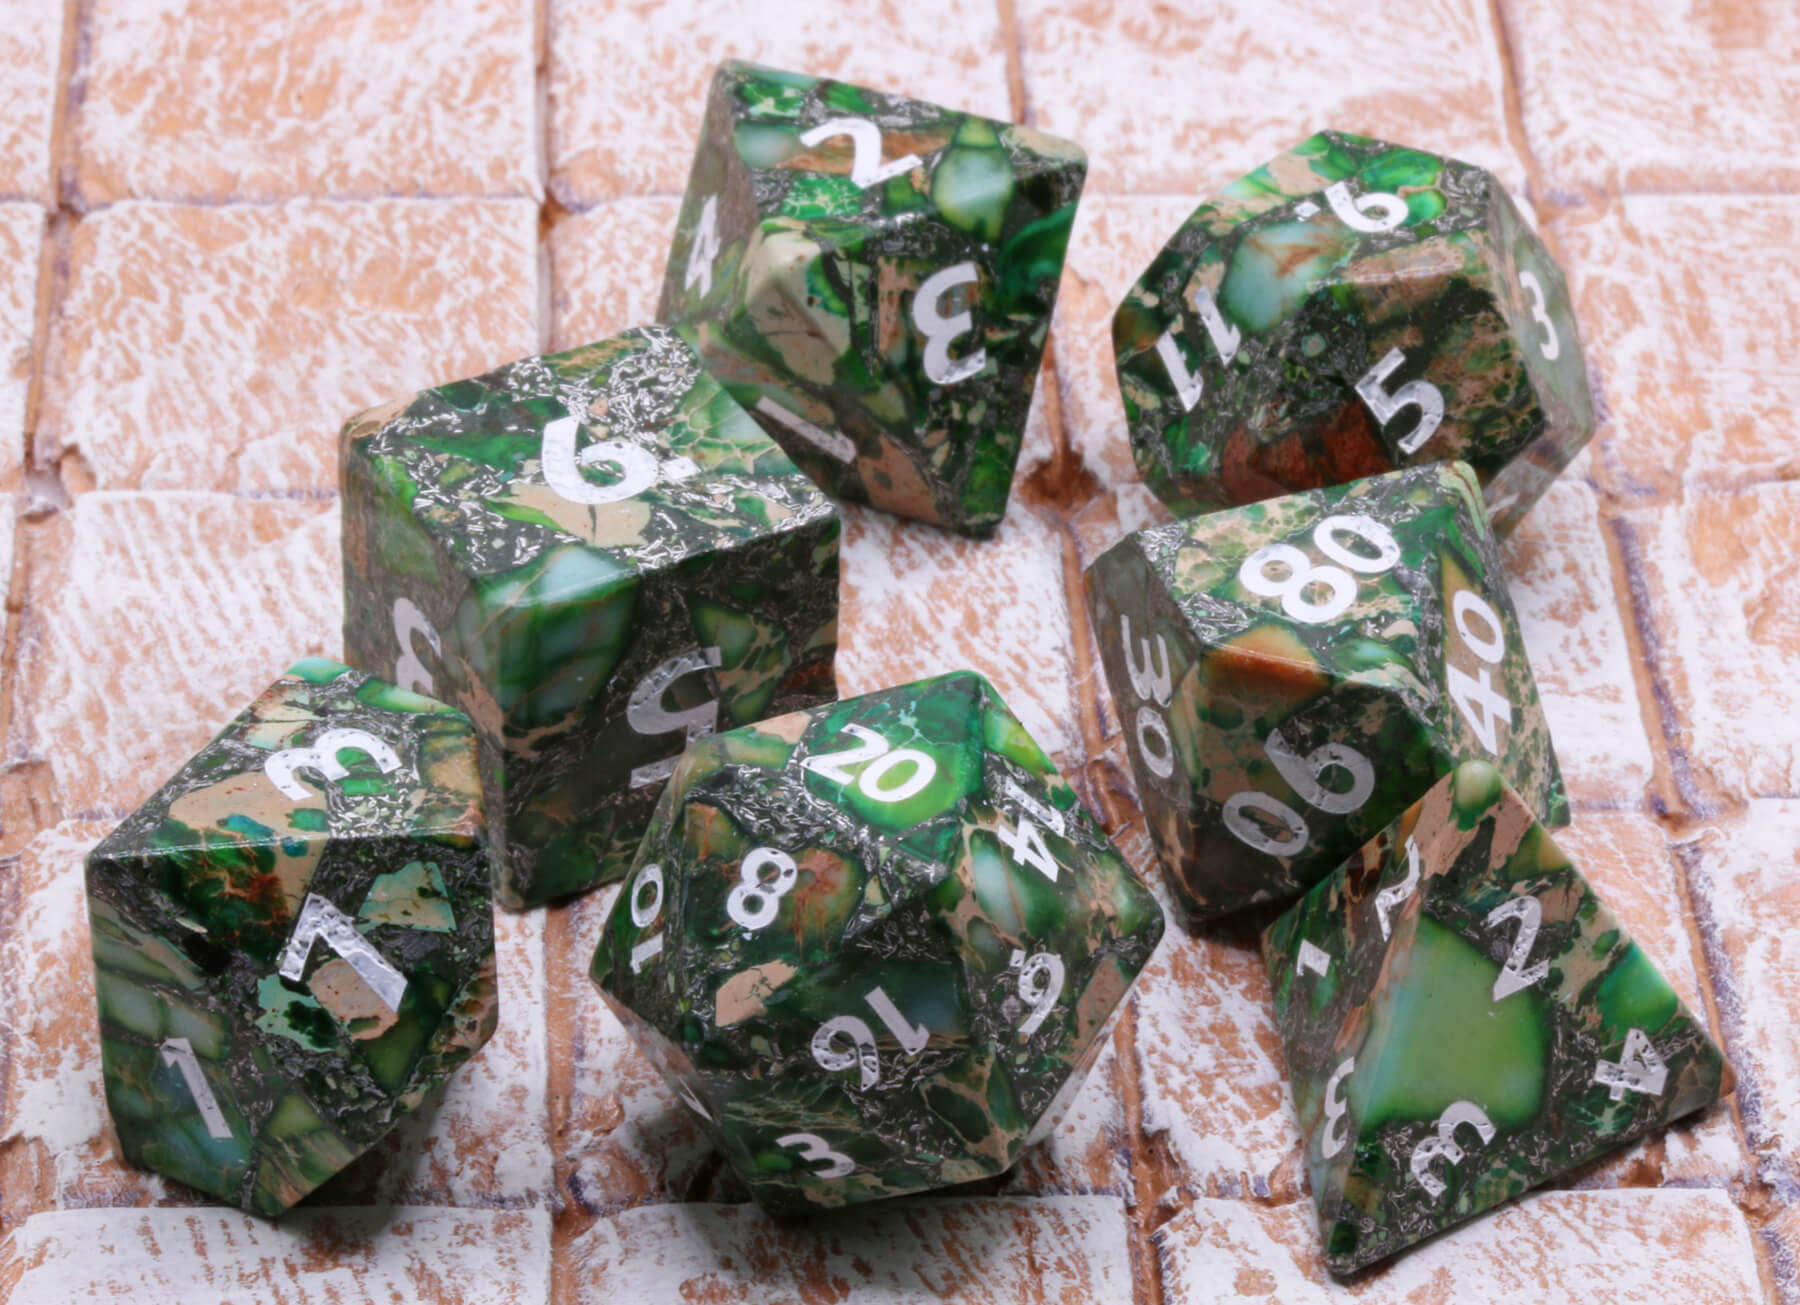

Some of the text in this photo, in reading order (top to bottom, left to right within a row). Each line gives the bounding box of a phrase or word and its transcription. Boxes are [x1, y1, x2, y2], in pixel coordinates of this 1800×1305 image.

[800, 118, 923, 188] 2
[912, 261, 987, 385] 3
[1519, 271, 1560, 361] 3
[1355, 347, 1444, 455] 5
[1240, 515, 1400, 624] 80
[1446, 589, 1512, 756] 40
[264, 728, 403, 801] 3
[800, 723, 937, 802] 20
[997, 777, 1065, 883] 14
[726, 847, 798, 930] 8
[1483, 895, 1549, 1001] 2
[160, 1038, 233, 1139] 1
[1321, 1057, 1354, 1160] 3
[1594, 1028, 1669, 1100] 4
[776, 1133, 857, 1180] 3
[1411, 1100, 1497, 1198] 3
